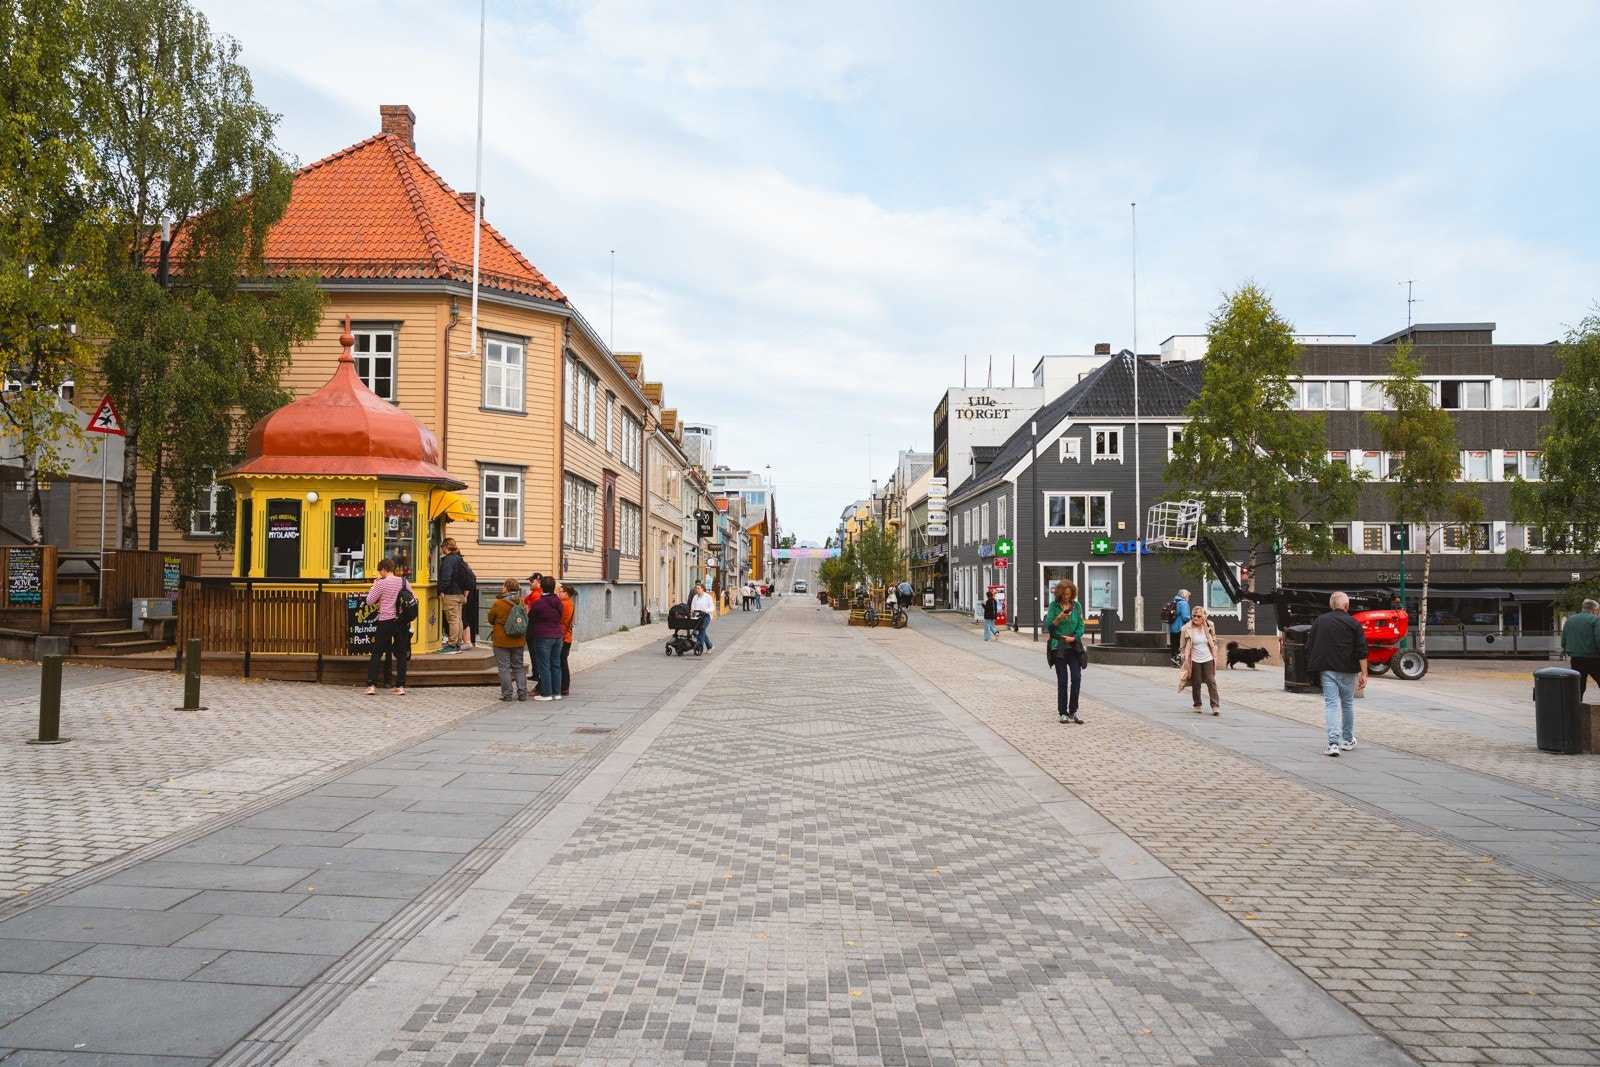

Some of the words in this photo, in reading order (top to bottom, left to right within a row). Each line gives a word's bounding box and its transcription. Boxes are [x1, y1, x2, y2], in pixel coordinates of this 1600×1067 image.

[968, 396, 997, 407] Lille
[955, 408, 1011, 420] TORGET
[462, 502, 474, 514] BAR
[1113, 541, 1150, 555] APO
[354, 634, 371, 645] Pork
